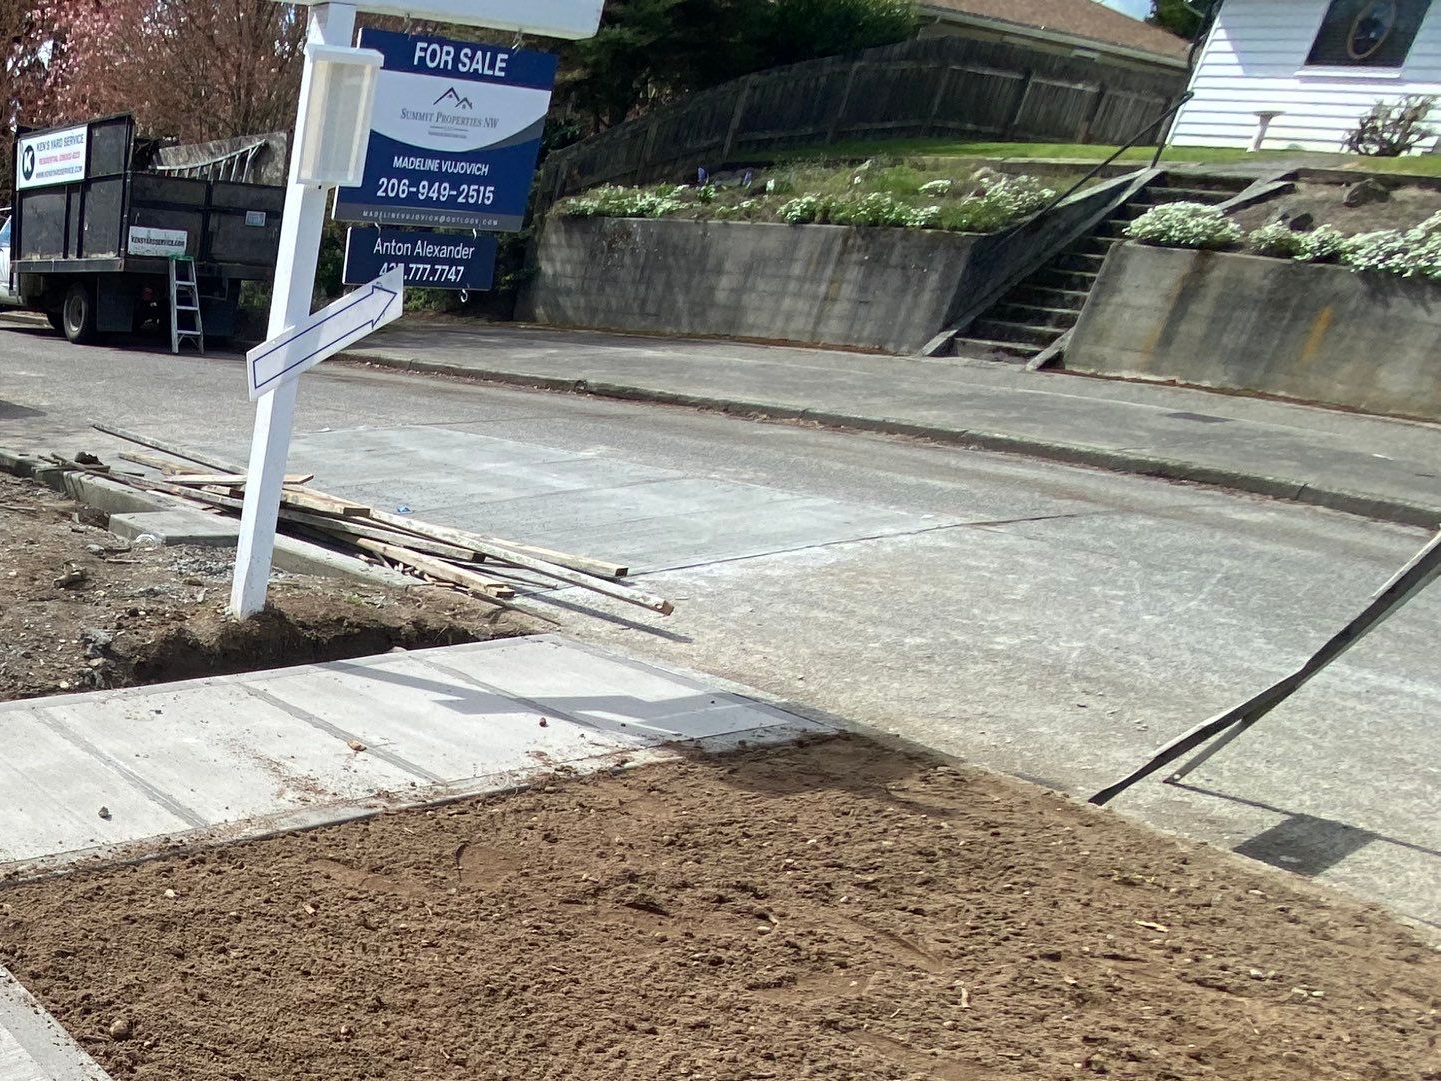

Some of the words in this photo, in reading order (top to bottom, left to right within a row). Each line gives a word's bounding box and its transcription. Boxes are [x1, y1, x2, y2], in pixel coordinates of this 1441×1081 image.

[414, 42, 454, 70] FOR
[459, 48, 509, 77] SALE
[483, 117, 499, 129] NW
[393, 156, 440, 172] MADELINE
[441, 160, 490, 176] VUJOVICH
[377, 177, 495, 205] 206-949-2515
[373, 238, 411, 256] Anton
[413, 240, 475, 259] Alexander
